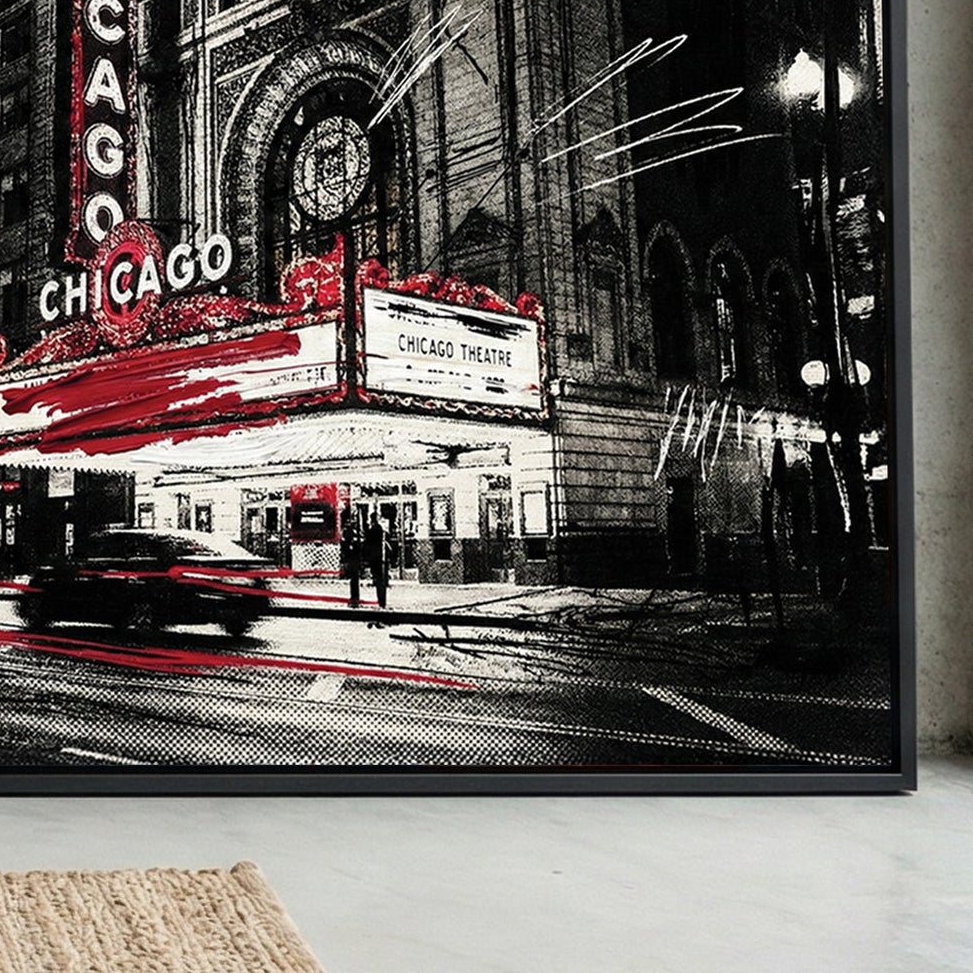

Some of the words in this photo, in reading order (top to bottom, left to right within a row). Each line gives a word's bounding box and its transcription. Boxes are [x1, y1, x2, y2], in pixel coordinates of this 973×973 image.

[39, 233, 233, 321] CHICAGO
[398, 333, 454, 359] CHICAGO
[460, 343, 512, 368] THEATRE
